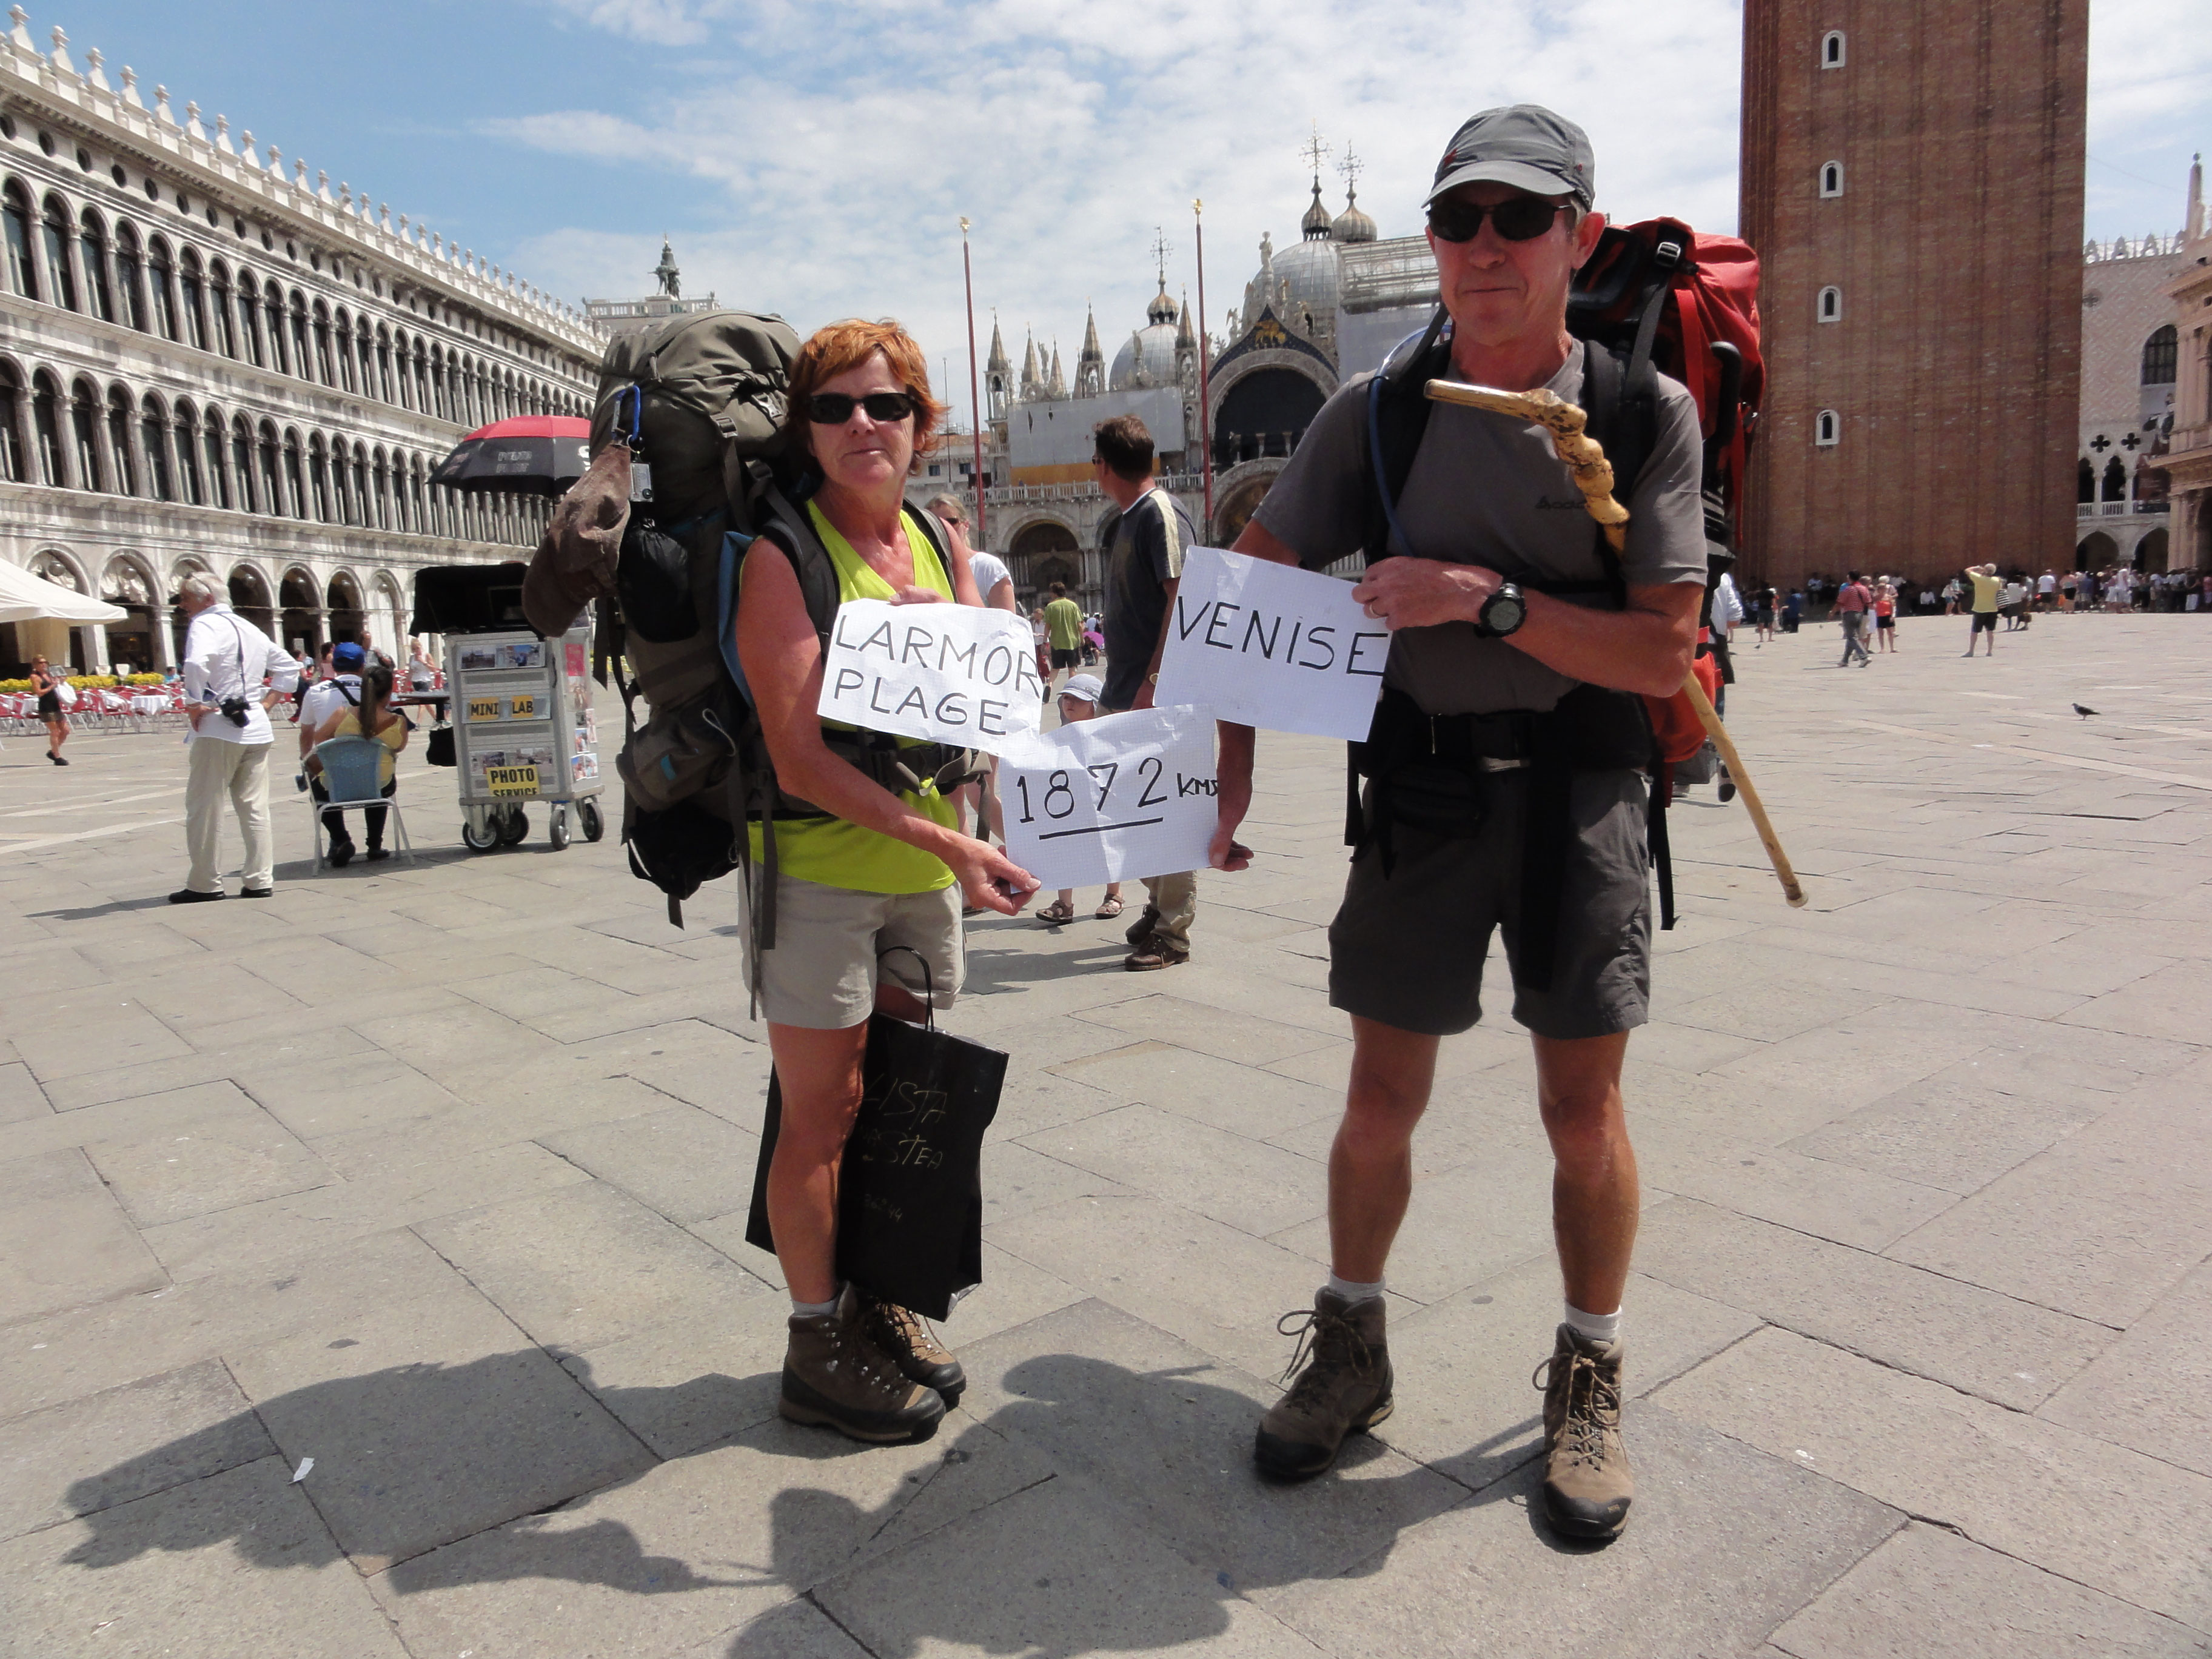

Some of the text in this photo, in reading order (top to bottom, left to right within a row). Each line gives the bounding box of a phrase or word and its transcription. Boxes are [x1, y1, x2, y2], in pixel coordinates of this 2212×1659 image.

[835, 615, 1041, 699] LARMOR
[471, 701, 534, 716] MINI LAB
[834, 668, 1009, 736] PLAGE
[490, 768, 535, 784] PHOTO
[1017, 757, 1168, 823] 1872
